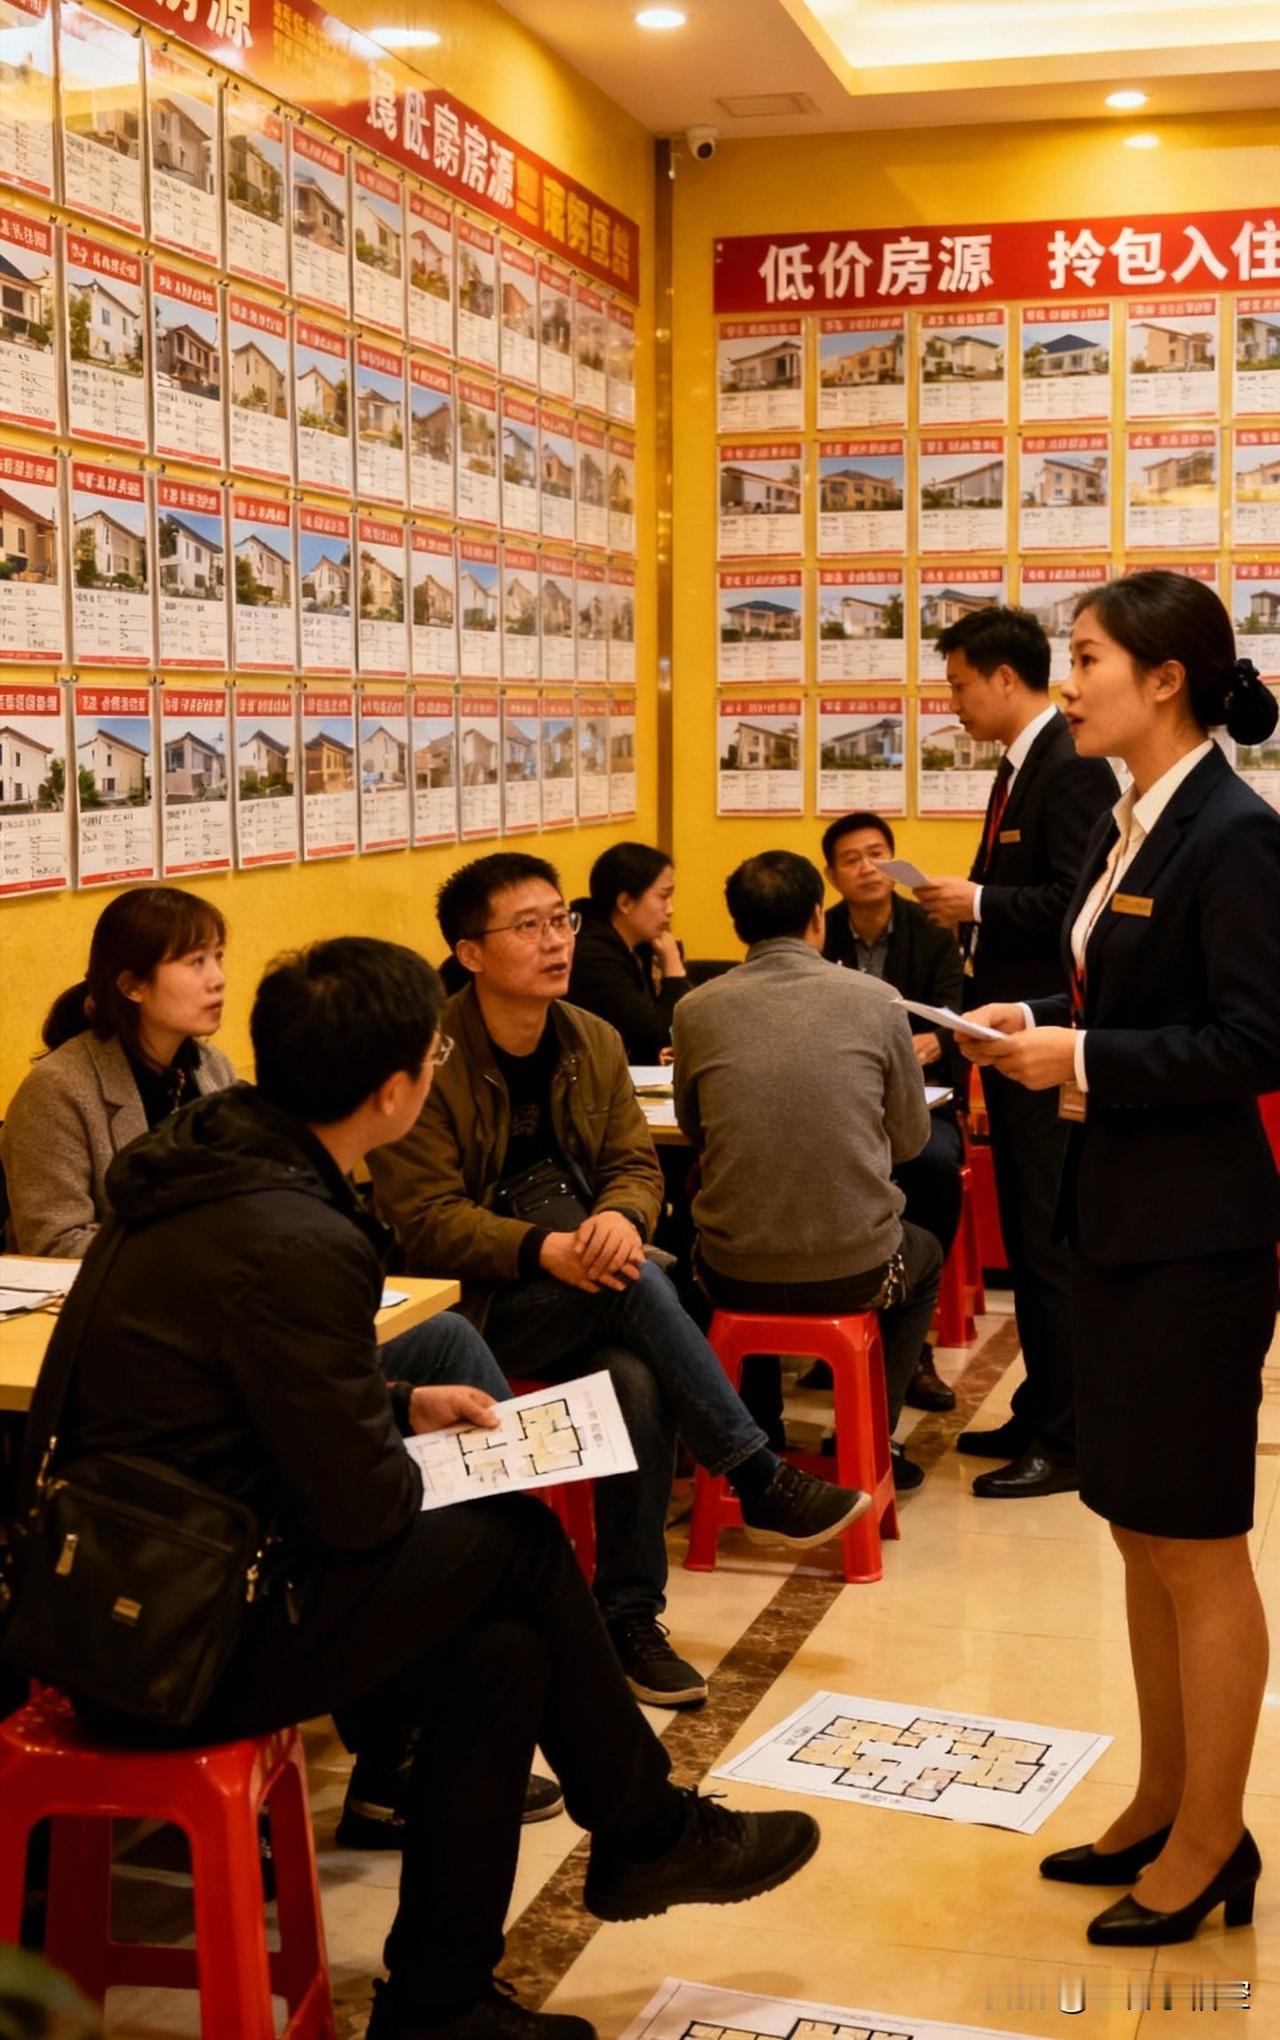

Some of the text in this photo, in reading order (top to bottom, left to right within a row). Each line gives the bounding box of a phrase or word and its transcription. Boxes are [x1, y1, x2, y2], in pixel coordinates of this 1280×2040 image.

[758, 219, 1280, 303] 低价房源 拎包入住
